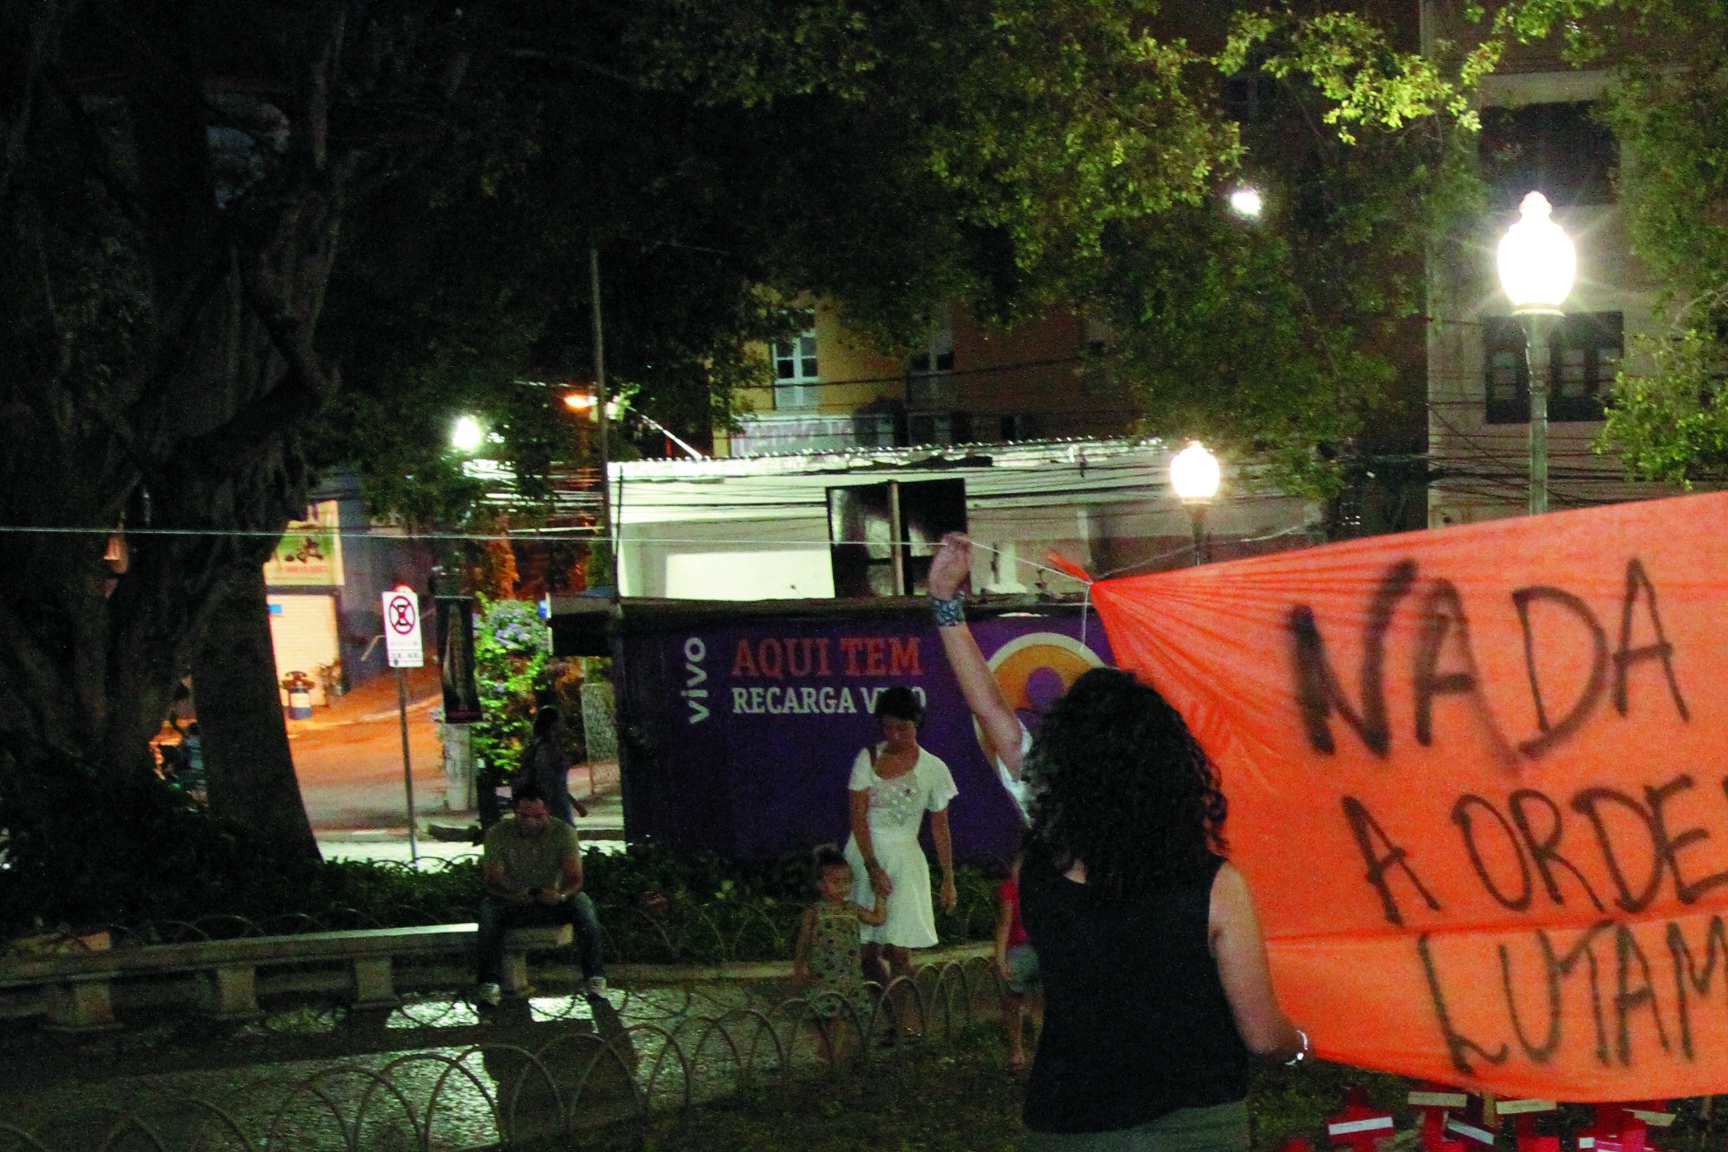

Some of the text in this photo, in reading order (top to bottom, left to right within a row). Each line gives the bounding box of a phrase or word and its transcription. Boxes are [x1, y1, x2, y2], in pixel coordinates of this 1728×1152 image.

[681, 636, 709, 725] vivo
[732, 636, 924, 680] AQUI TEM
[732, 686, 857, 715] RECARGA
[1286, 556, 1690, 772] NADA
[1344, 796, 1438, 924] A
